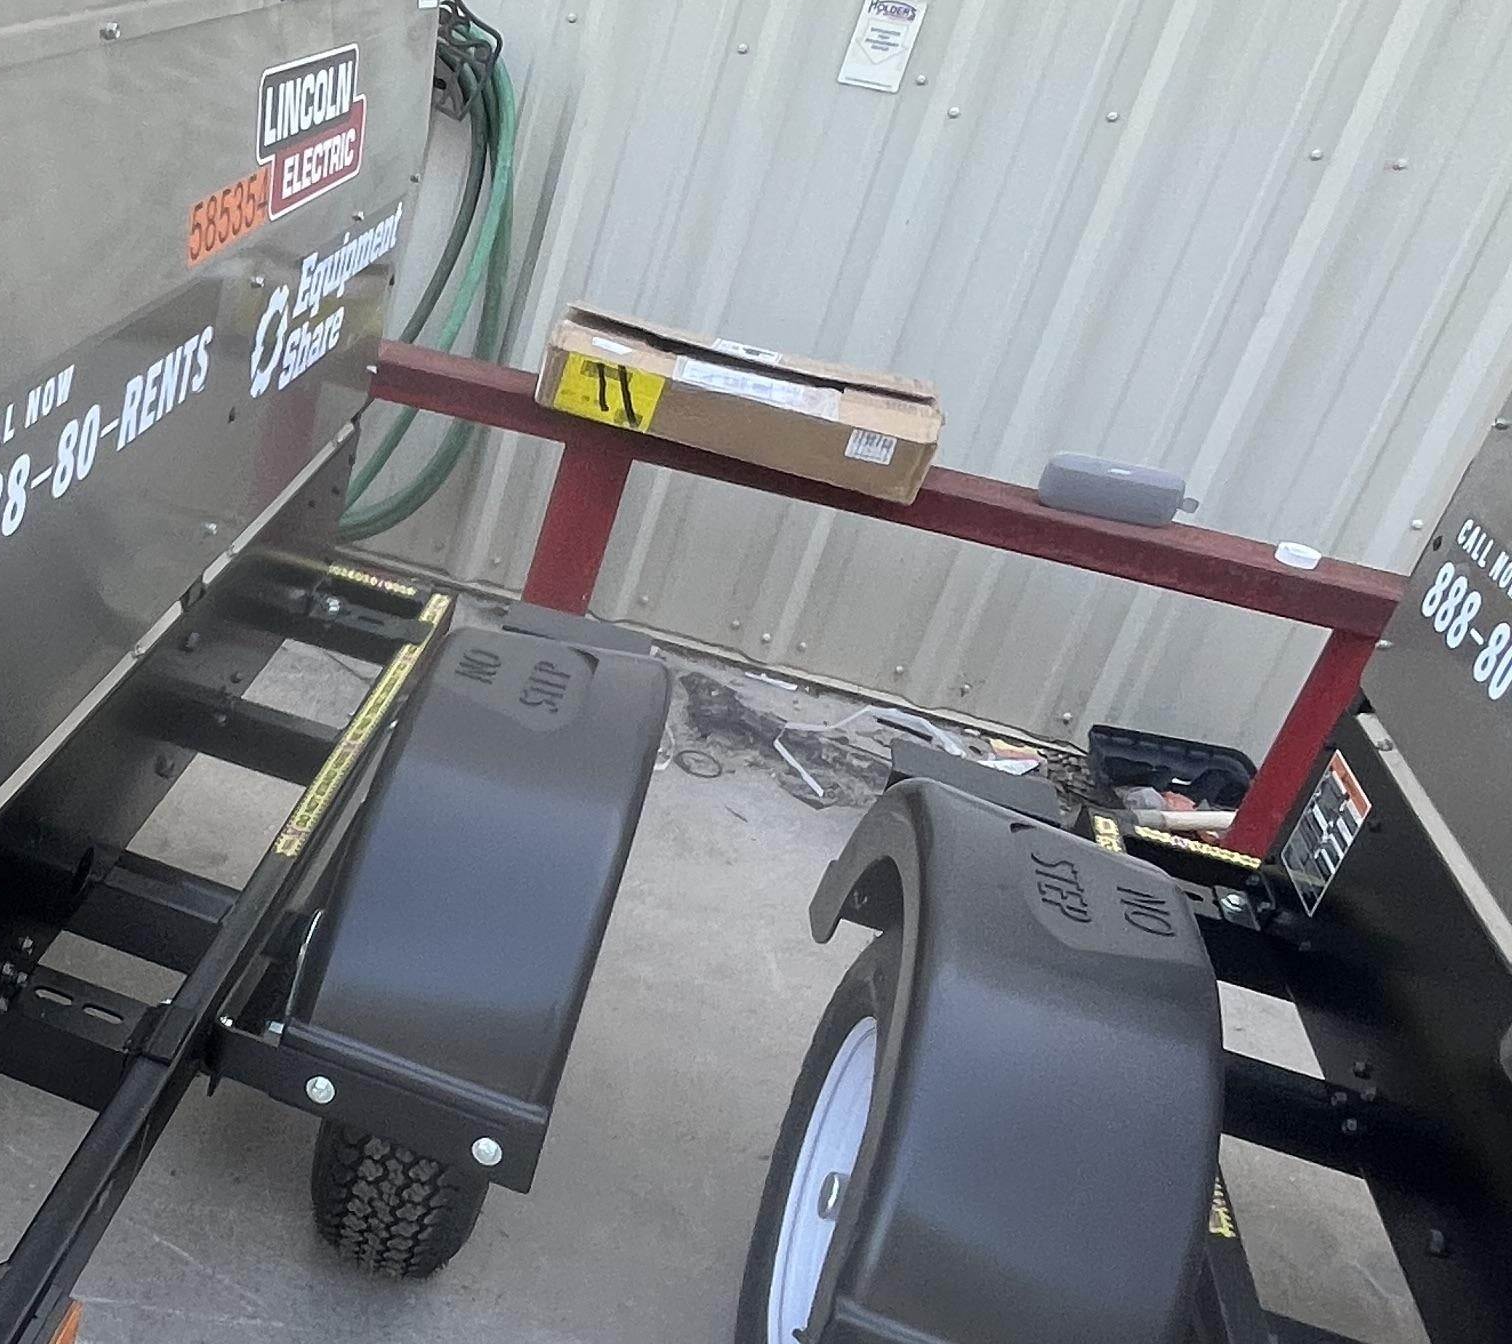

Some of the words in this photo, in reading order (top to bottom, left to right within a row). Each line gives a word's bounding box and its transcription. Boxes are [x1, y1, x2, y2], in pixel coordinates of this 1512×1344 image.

[264, 60, 354, 147] LINCOLN
[282, 128, 356, 200] ELECTRIC
[292, 202, 403, 319] Equipment
[278, 306, 345, 391] Share
[24, 364, 75, 429] NOW
[1456, 519, 1494, 568] CALL
[1030, 853, 1093, 923] STEP
[1116, 886, 1177, 937] NO
